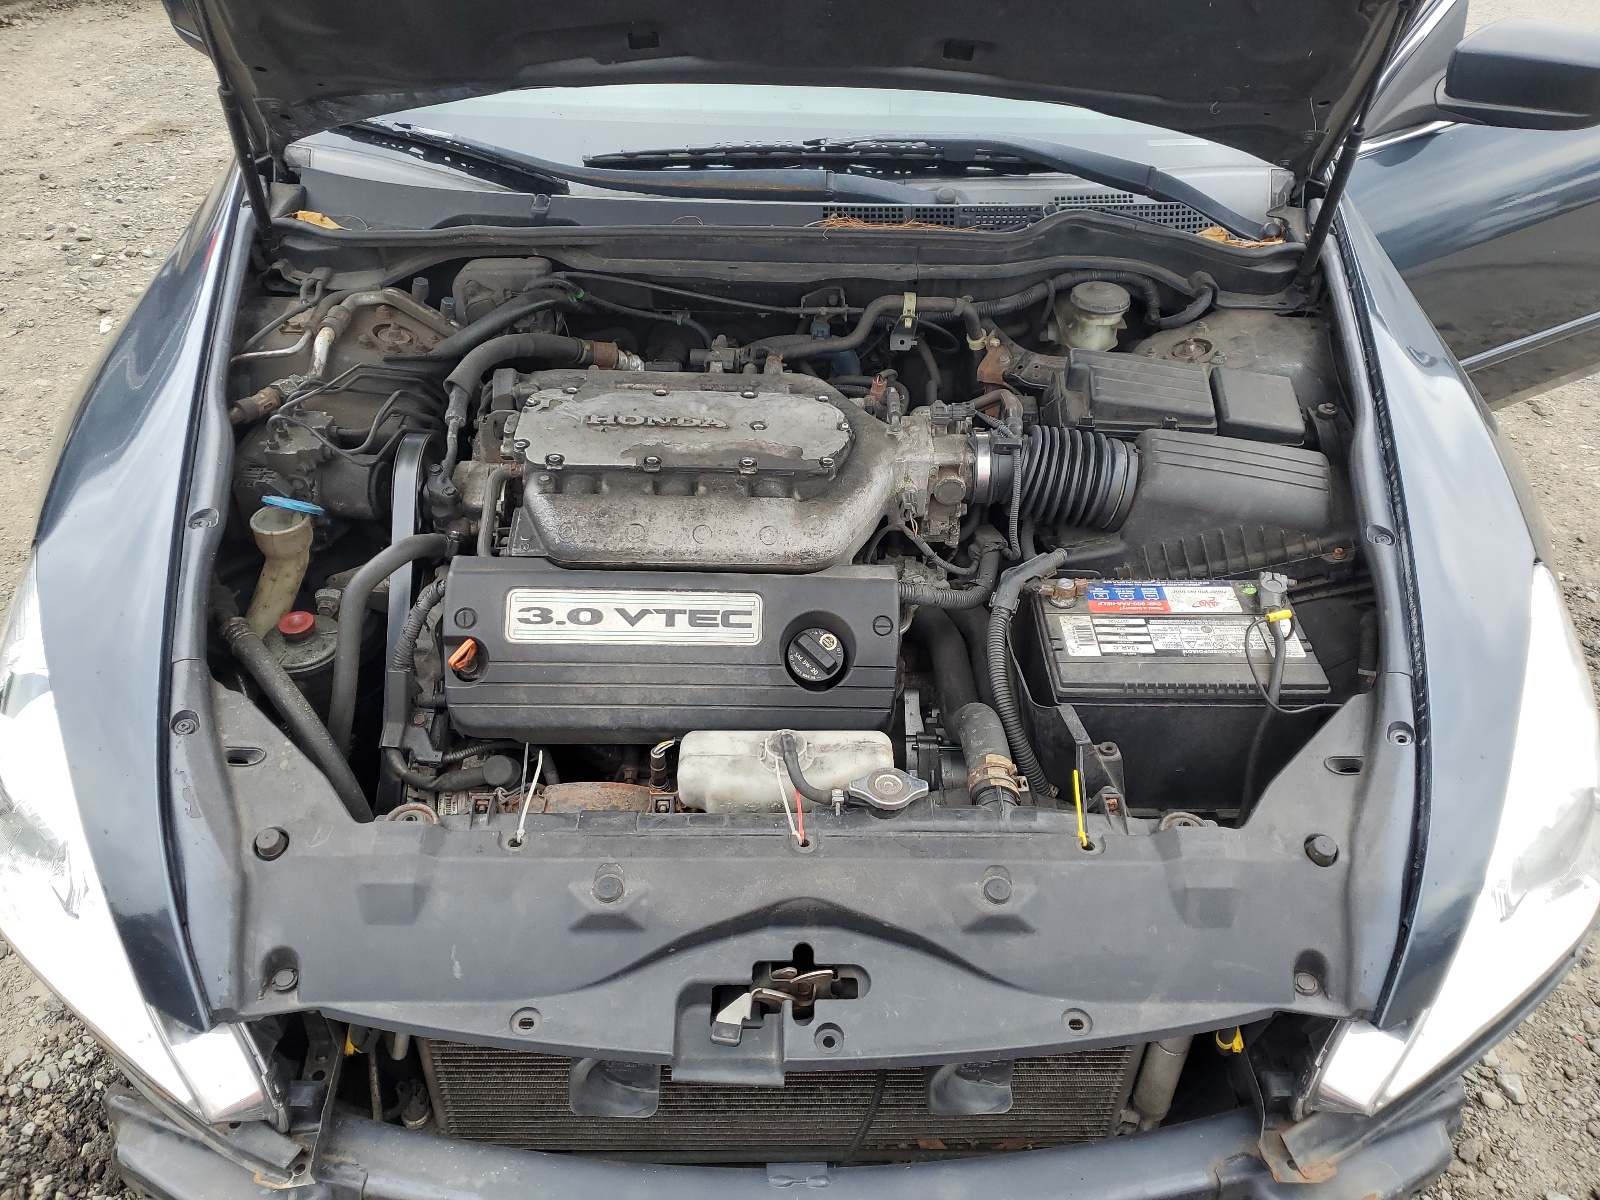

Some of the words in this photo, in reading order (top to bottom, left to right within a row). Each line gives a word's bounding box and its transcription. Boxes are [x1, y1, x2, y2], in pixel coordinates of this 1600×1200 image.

[586, 414, 730, 429] HONDA
[516, 606, 604, 626] 3.0
[613, 607, 753, 629] VTEC
